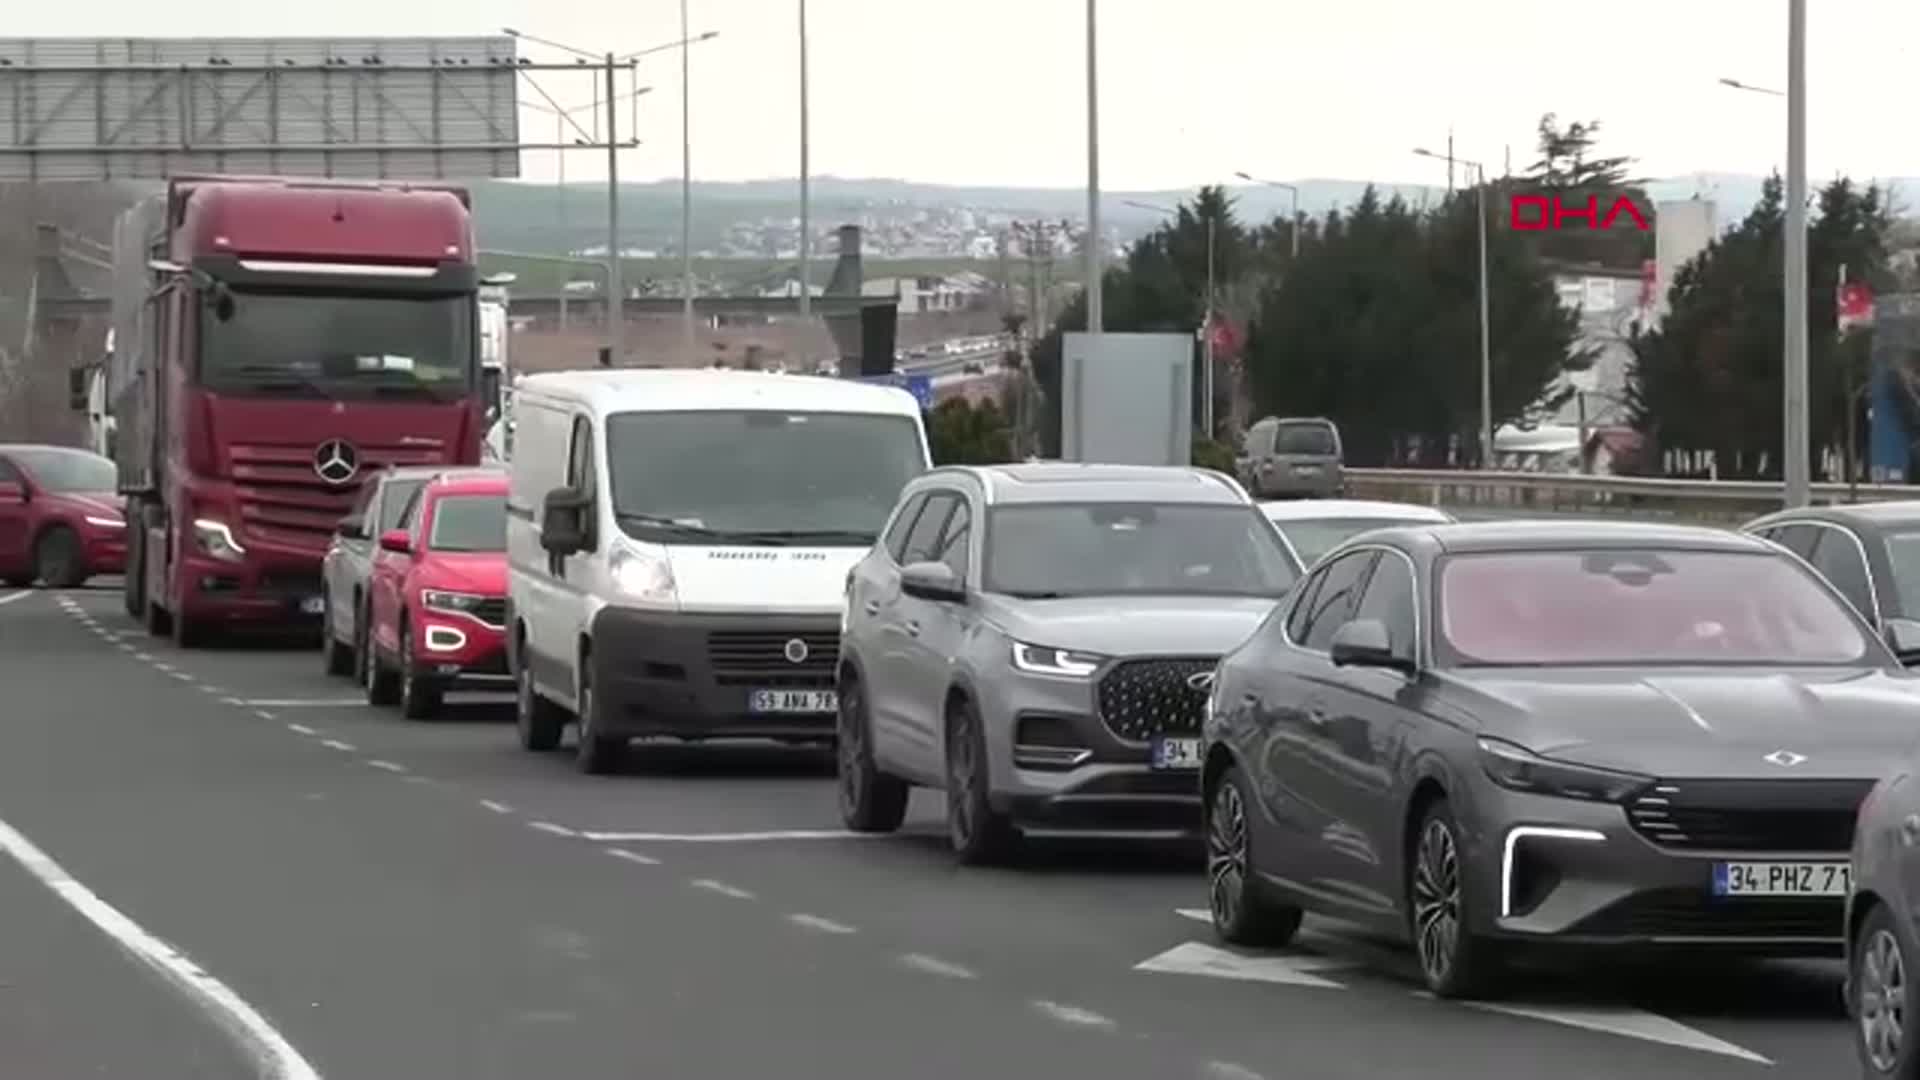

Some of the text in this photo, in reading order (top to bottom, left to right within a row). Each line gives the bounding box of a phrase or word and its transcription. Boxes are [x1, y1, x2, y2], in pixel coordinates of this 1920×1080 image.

[1166, 741, 1188, 760] 34
[1730, 866, 1758, 891] 34
[1769, 866, 1813, 892] PHZ
